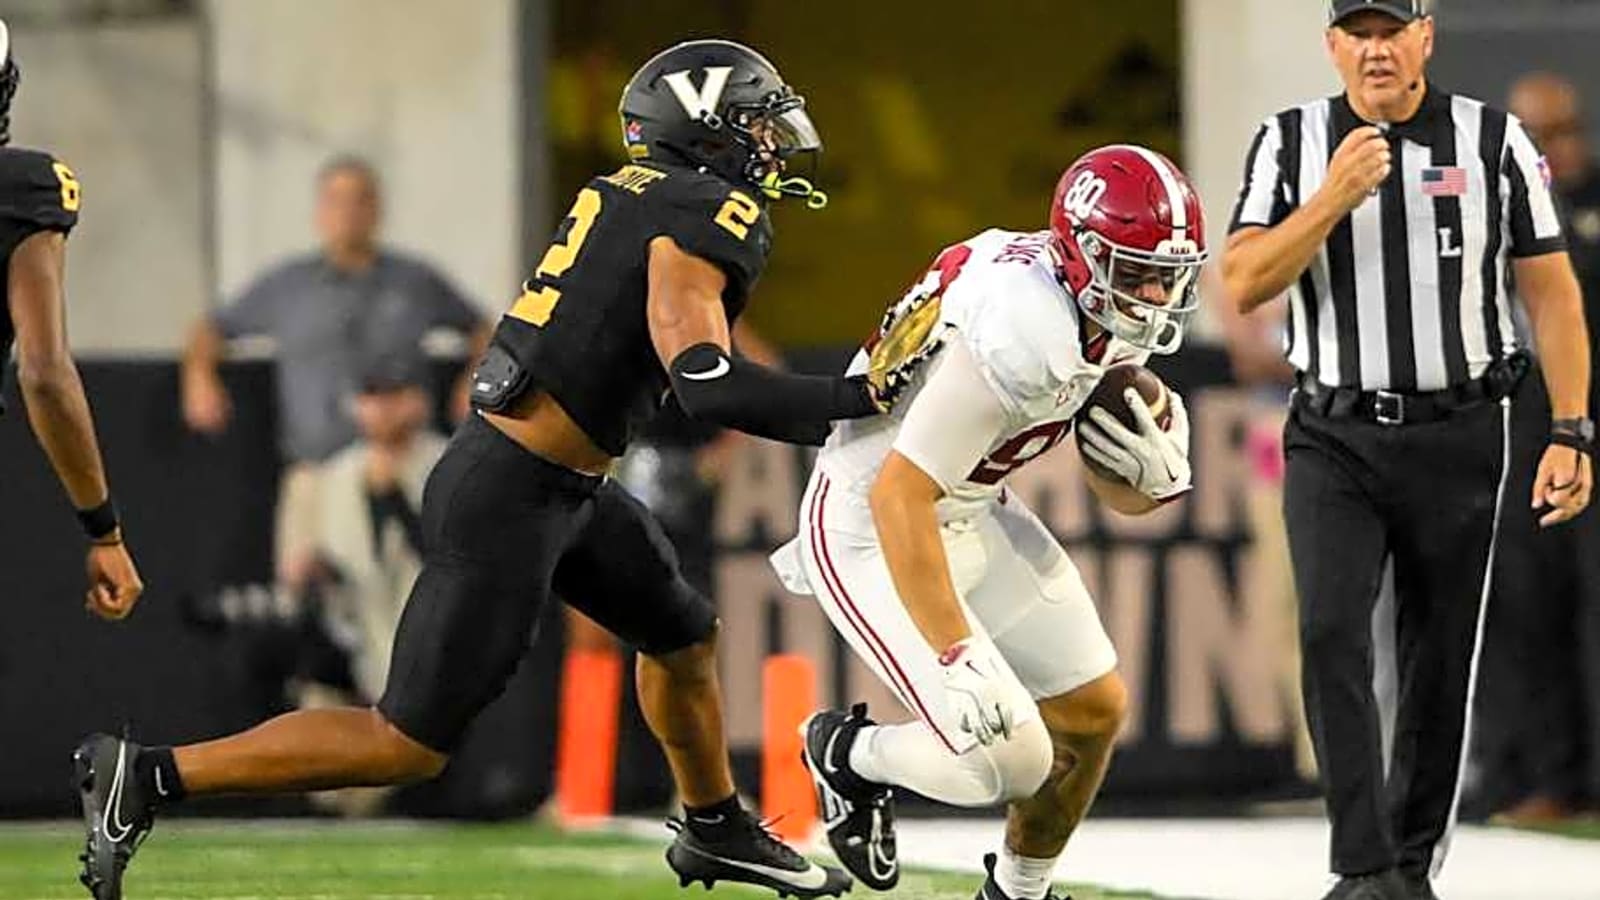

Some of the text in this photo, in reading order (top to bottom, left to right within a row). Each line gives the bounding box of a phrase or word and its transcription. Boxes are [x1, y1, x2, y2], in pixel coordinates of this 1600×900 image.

[661, 66, 734, 119] V
[53, 162, 80, 212] 6
[1064, 170, 1107, 218] 80
[714, 190, 760, 240] 2
[503, 187, 602, 327] 2
[1438, 227, 1462, 257] L
